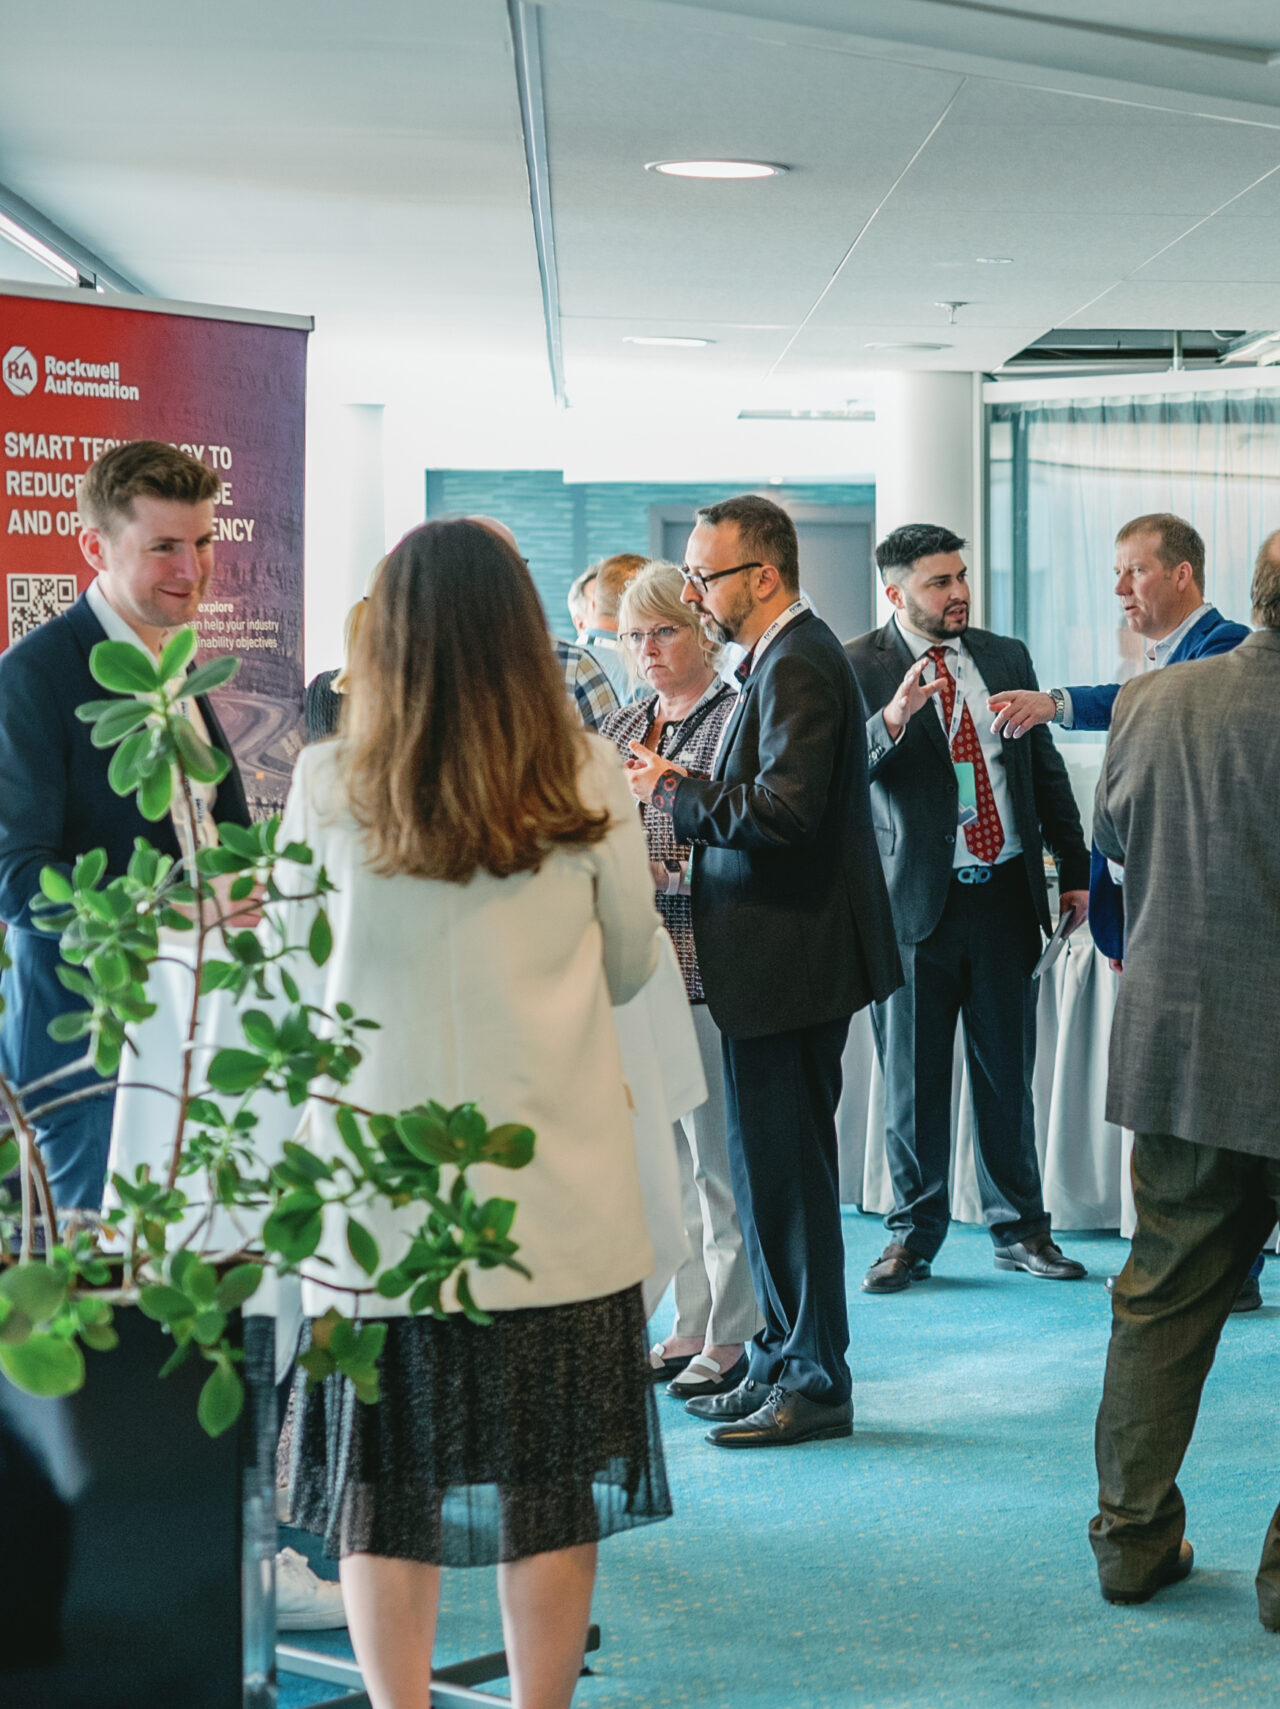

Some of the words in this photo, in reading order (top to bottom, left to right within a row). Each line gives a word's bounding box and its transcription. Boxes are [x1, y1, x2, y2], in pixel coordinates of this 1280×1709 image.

[7, 361, 33, 381] RA
[44, 355, 120, 380] Rockwell
[44, 375, 140, 401] Automation
[4, 432, 75, 461] SMART
[208, 445, 233, 470] TO
[7, 509, 53, 536] AND
[197, 600, 234, 615] explore
[204, 618, 225, 633] help
[225, 620, 246, 633] your
[246, 619, 279, 633] industry
[236, 635, 278, 651] objectives
